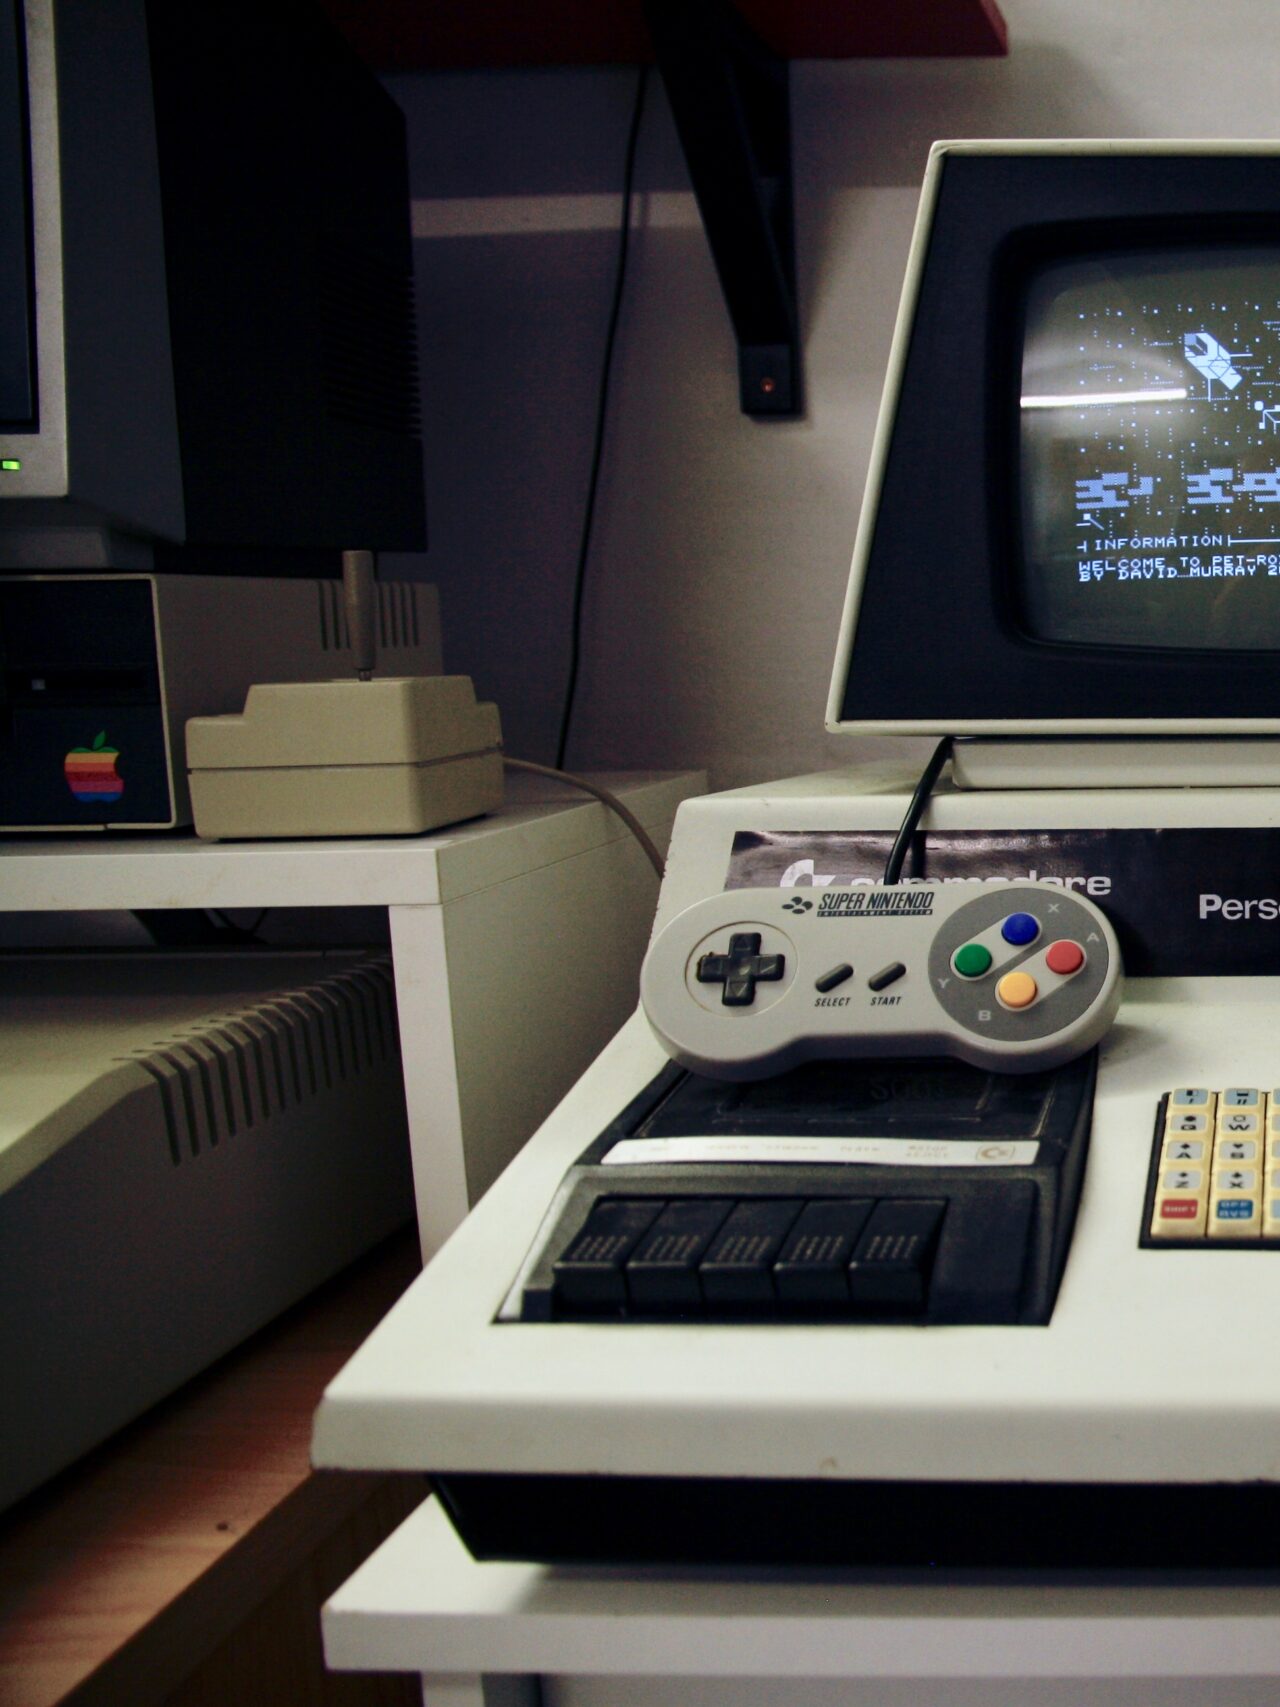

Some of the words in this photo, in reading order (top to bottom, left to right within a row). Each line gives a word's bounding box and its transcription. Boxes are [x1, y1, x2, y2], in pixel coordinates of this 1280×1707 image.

[1095, 535, 1223, 551] INFORMATION
[1079, 557, 1166, 572] WELCOME
[1180, 556, 1200, 567] TO
[1079, 570, 1104, 582] BY
[1118, 567, 1178, 580] DAVID
[1190, 564, 1256, 577] MURRAY
[818, 892, 866, 910] SUPER
[866, 891, 935, 909] NINTENDO
[1048, 903, 1060, 914] X
[1086, 932, 1100, 943] A
[937, 978, 950, 989] Y
[814, 997, 851, 1007] SELECT
[870, 996, 902, 1006] START
[978, 1010, 992, 1021] B
[1228, 1123, 1250, 1131] W
